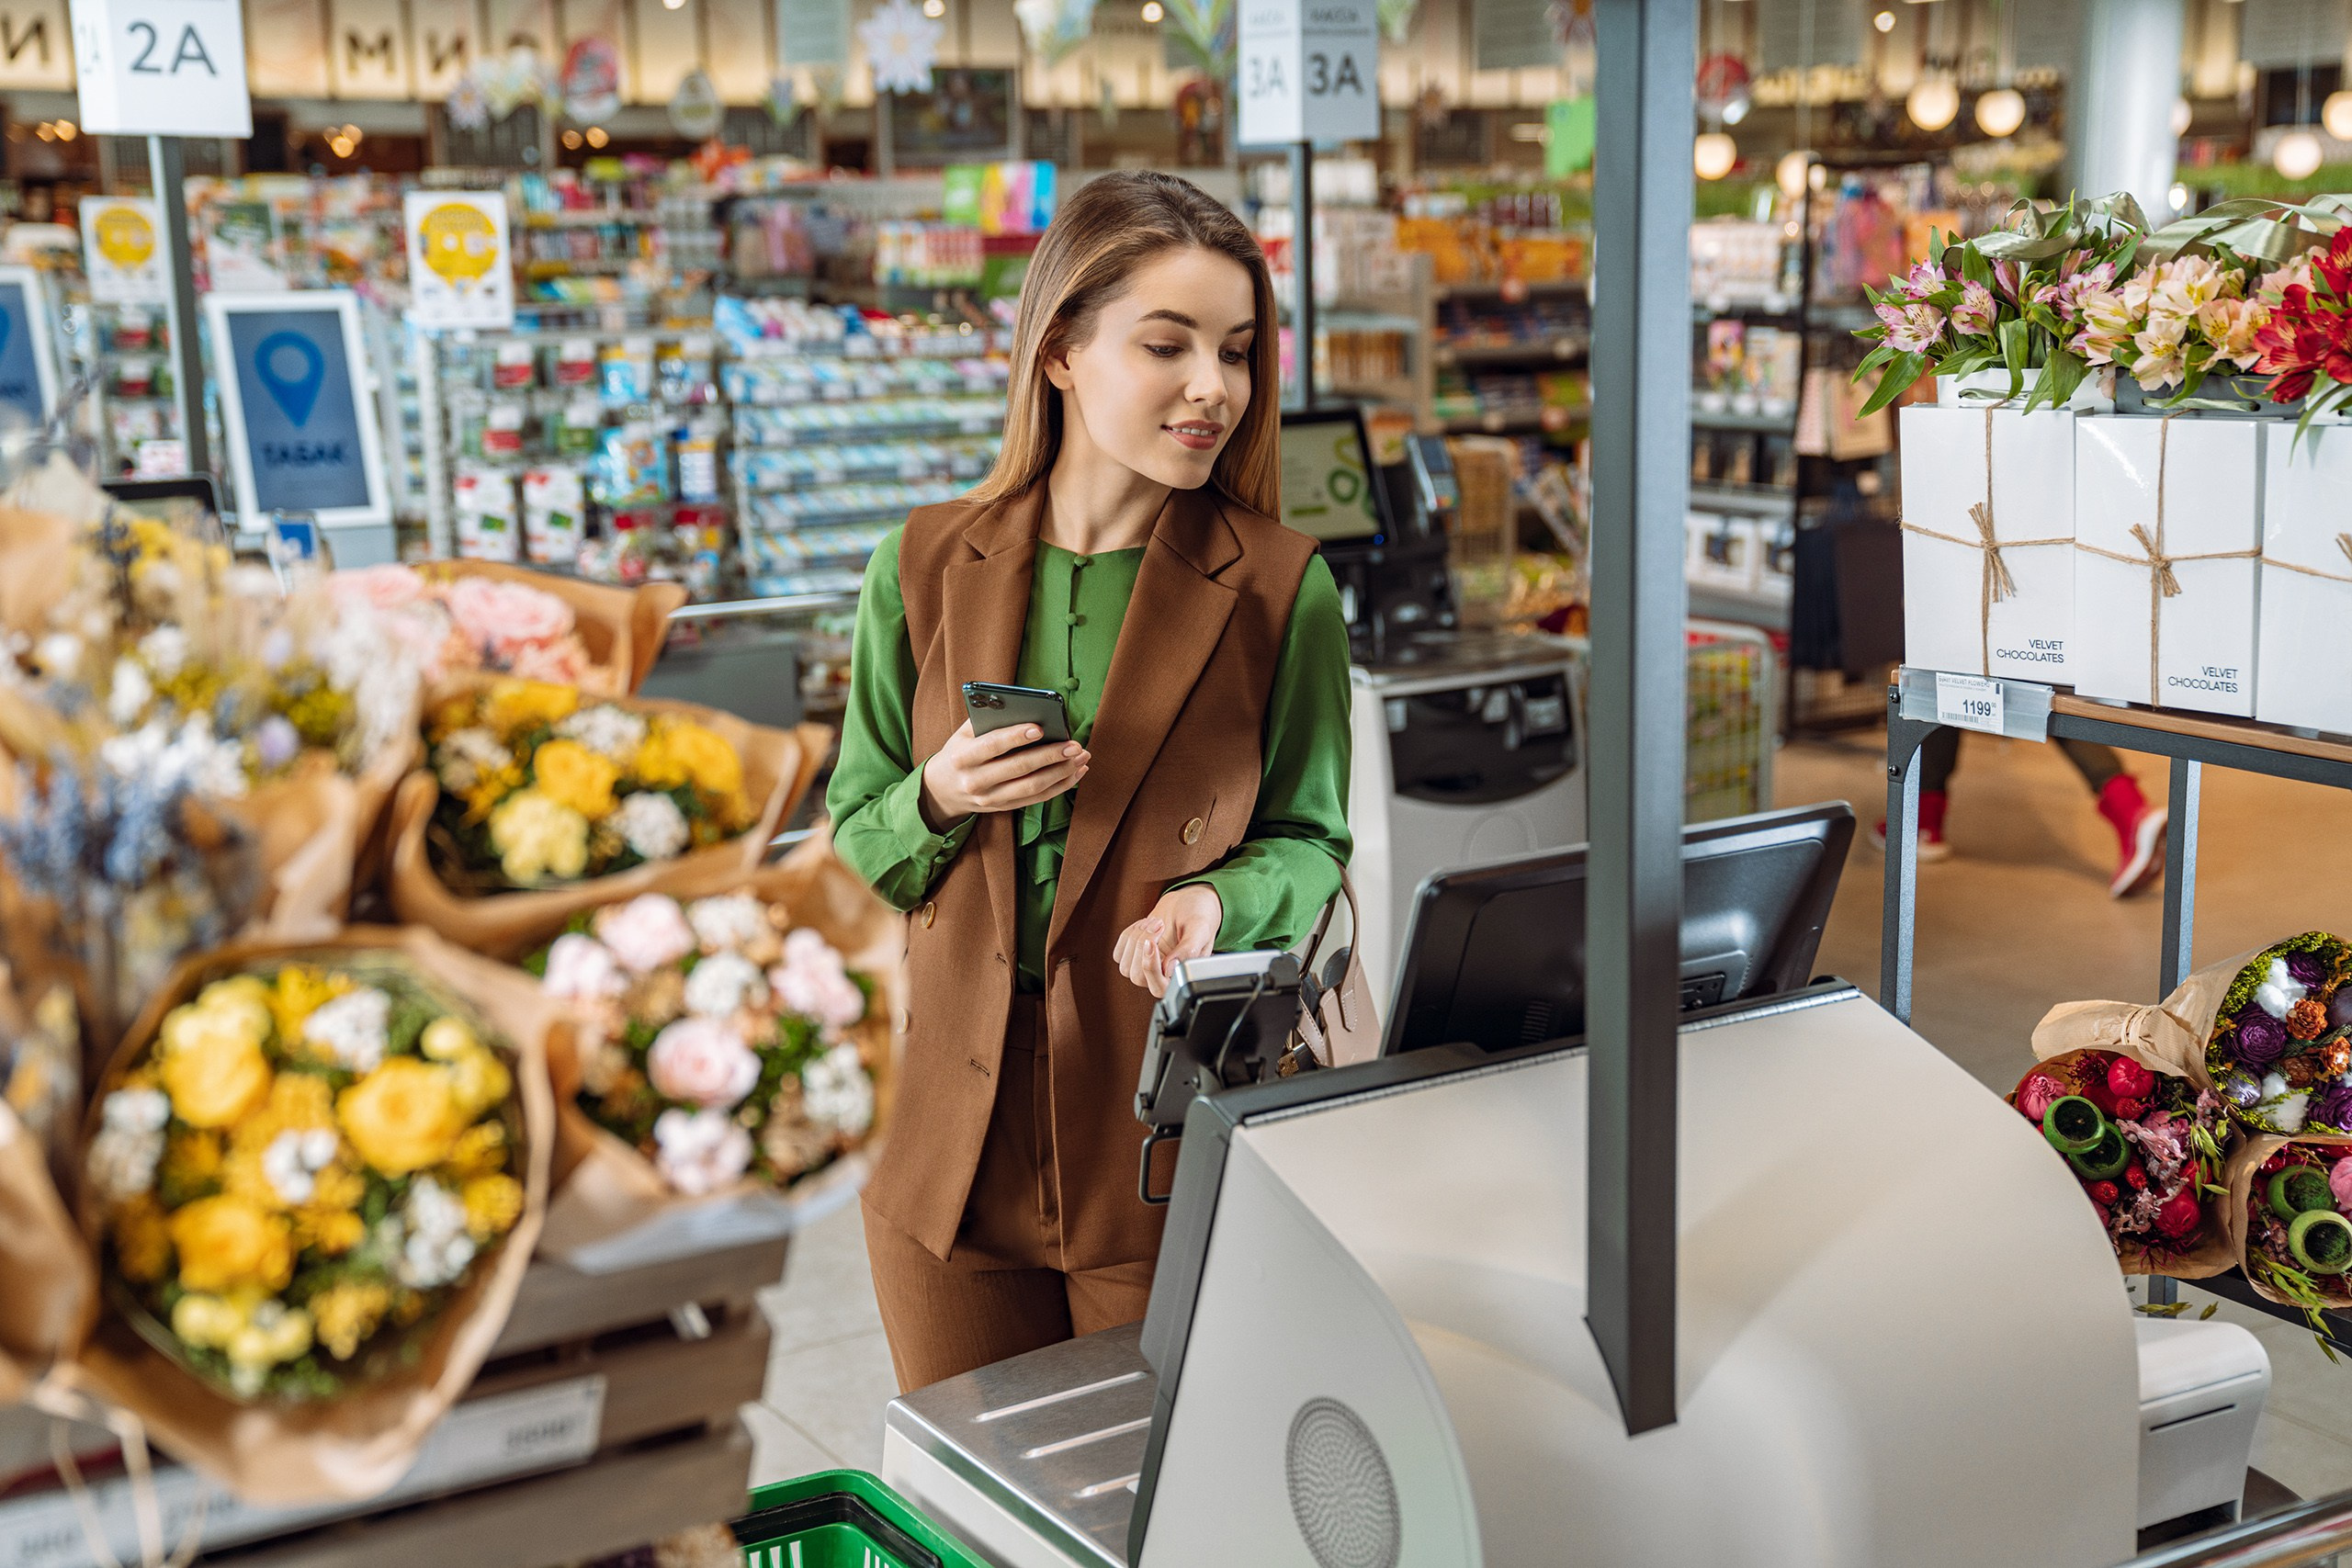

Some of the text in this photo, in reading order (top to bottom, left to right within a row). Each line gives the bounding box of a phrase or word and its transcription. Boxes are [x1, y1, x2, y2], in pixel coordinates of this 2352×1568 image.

[2028, 638, 2064, 650] VELVET
[1996, 649, 2064, 663] CHOCOLATES
[2201, 666, 2238, 679] VELVET
[2167, 676, 2238, 693] CHOCOLATES
[1962, 698, 1991, 716] 1199
